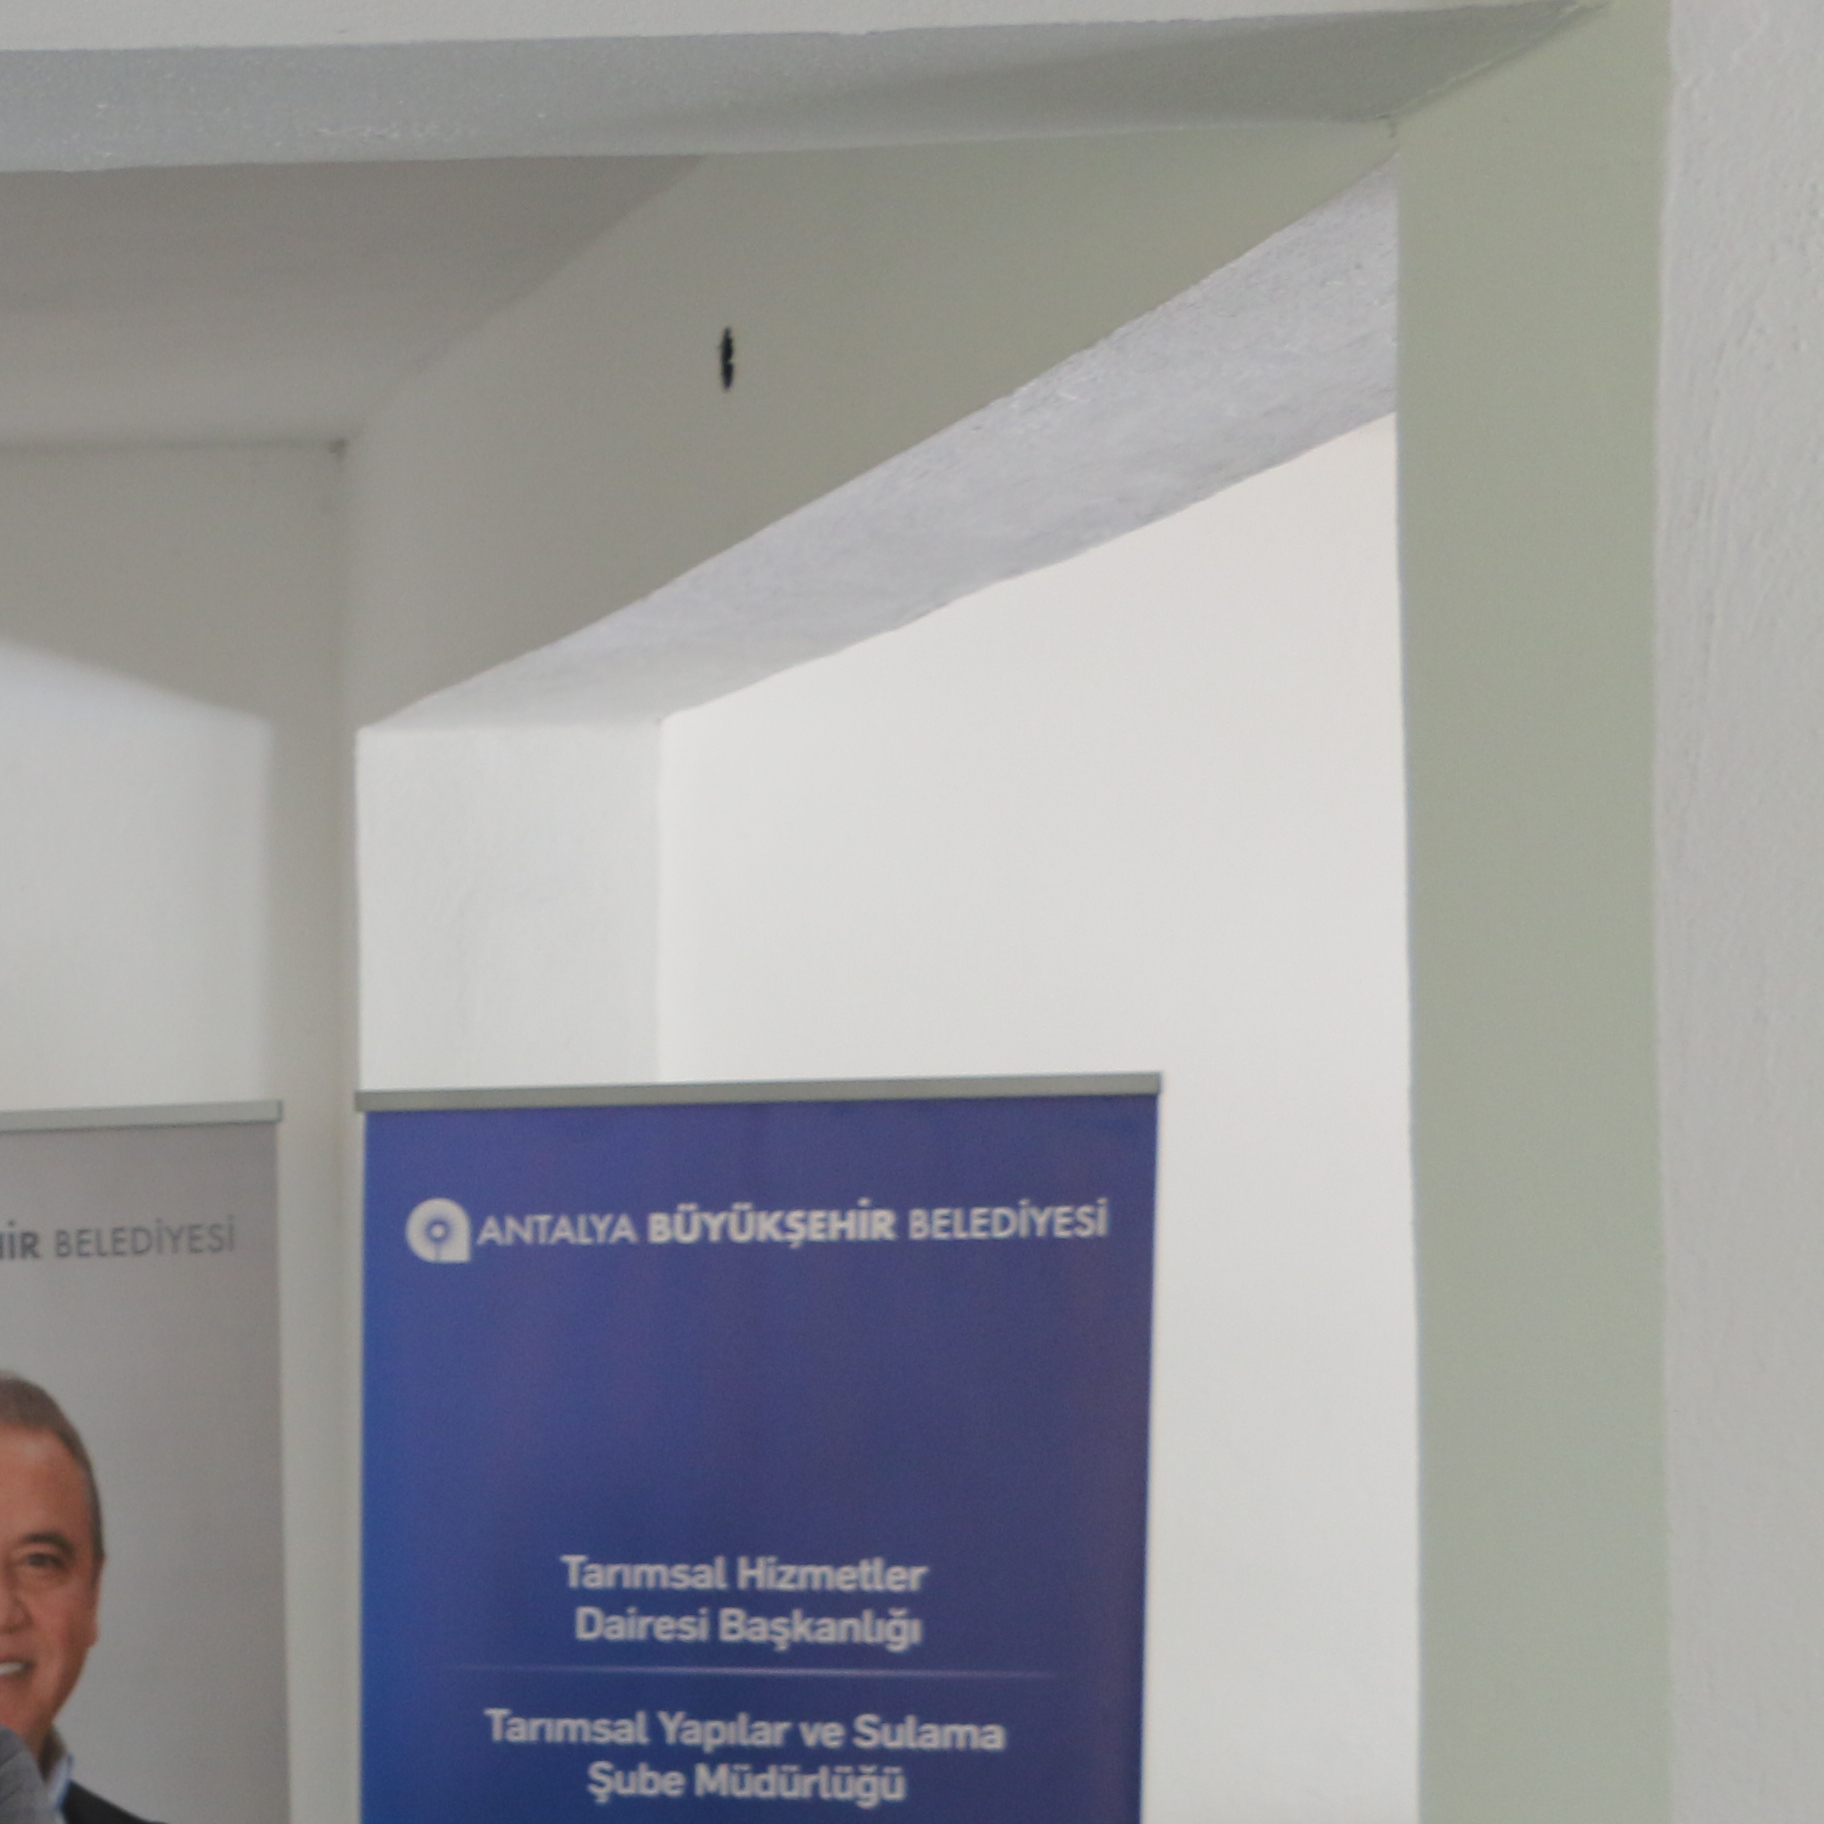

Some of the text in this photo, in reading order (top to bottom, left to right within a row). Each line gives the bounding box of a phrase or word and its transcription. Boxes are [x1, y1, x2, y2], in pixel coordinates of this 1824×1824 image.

[54, 1213, 237, 1260] BELEDİYESİ
[476, 1197, 1108, 1249] ANTALYA BÜYÜKŞEHİR BELEDİYESİ
[559, 1554, 929, 1593] Tarımsal Hizmetler
[575, 1605, 923, 1653] Dairesi Başkanlığı
[483, 1707, 1007, 1754] Tarımsal Yapılar ve Sulama
[587, 1760, 907, 1810] Şube Müdürlüğü
